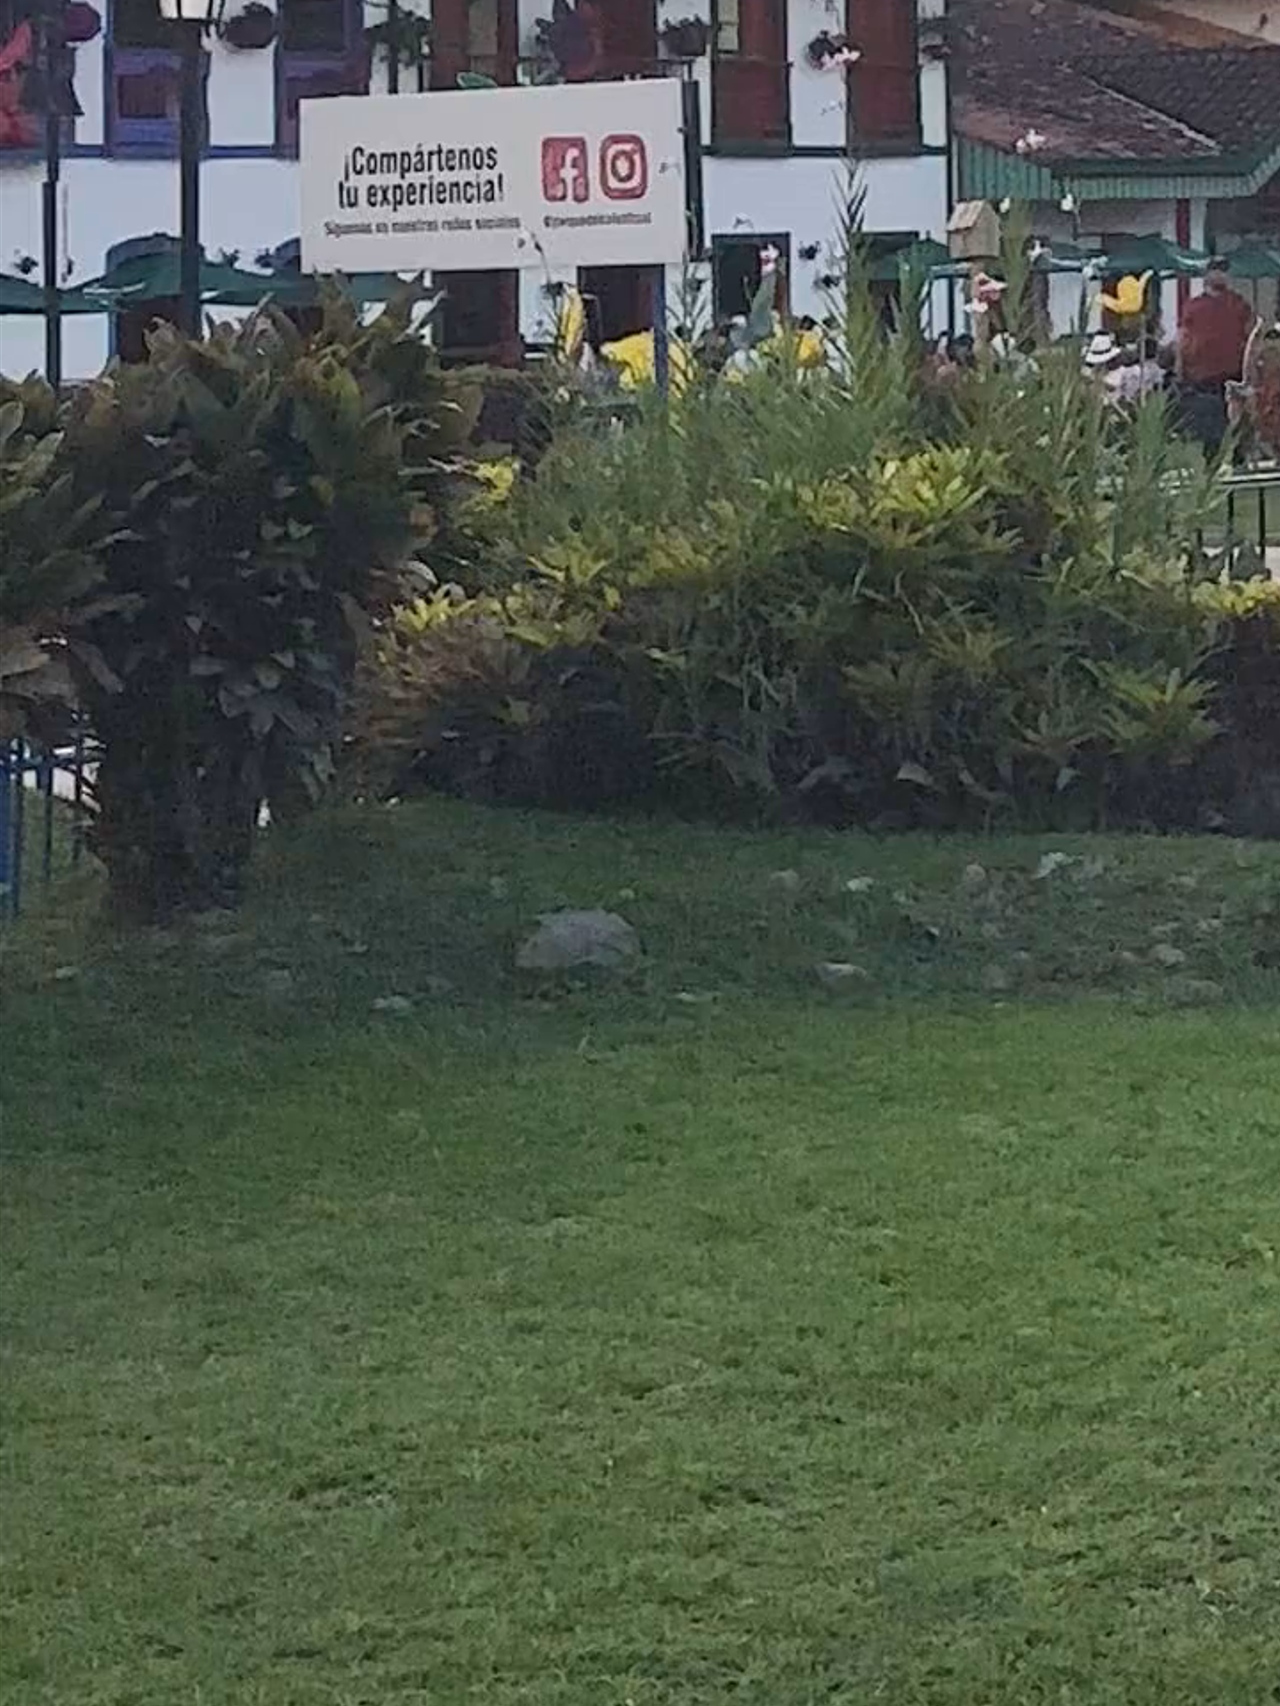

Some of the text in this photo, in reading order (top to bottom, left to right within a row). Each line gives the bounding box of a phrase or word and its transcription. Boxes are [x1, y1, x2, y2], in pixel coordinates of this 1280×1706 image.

[344, 143, 498, 182] ¡Compártenos
[338, 172, 504, 213] tu experiencia!
